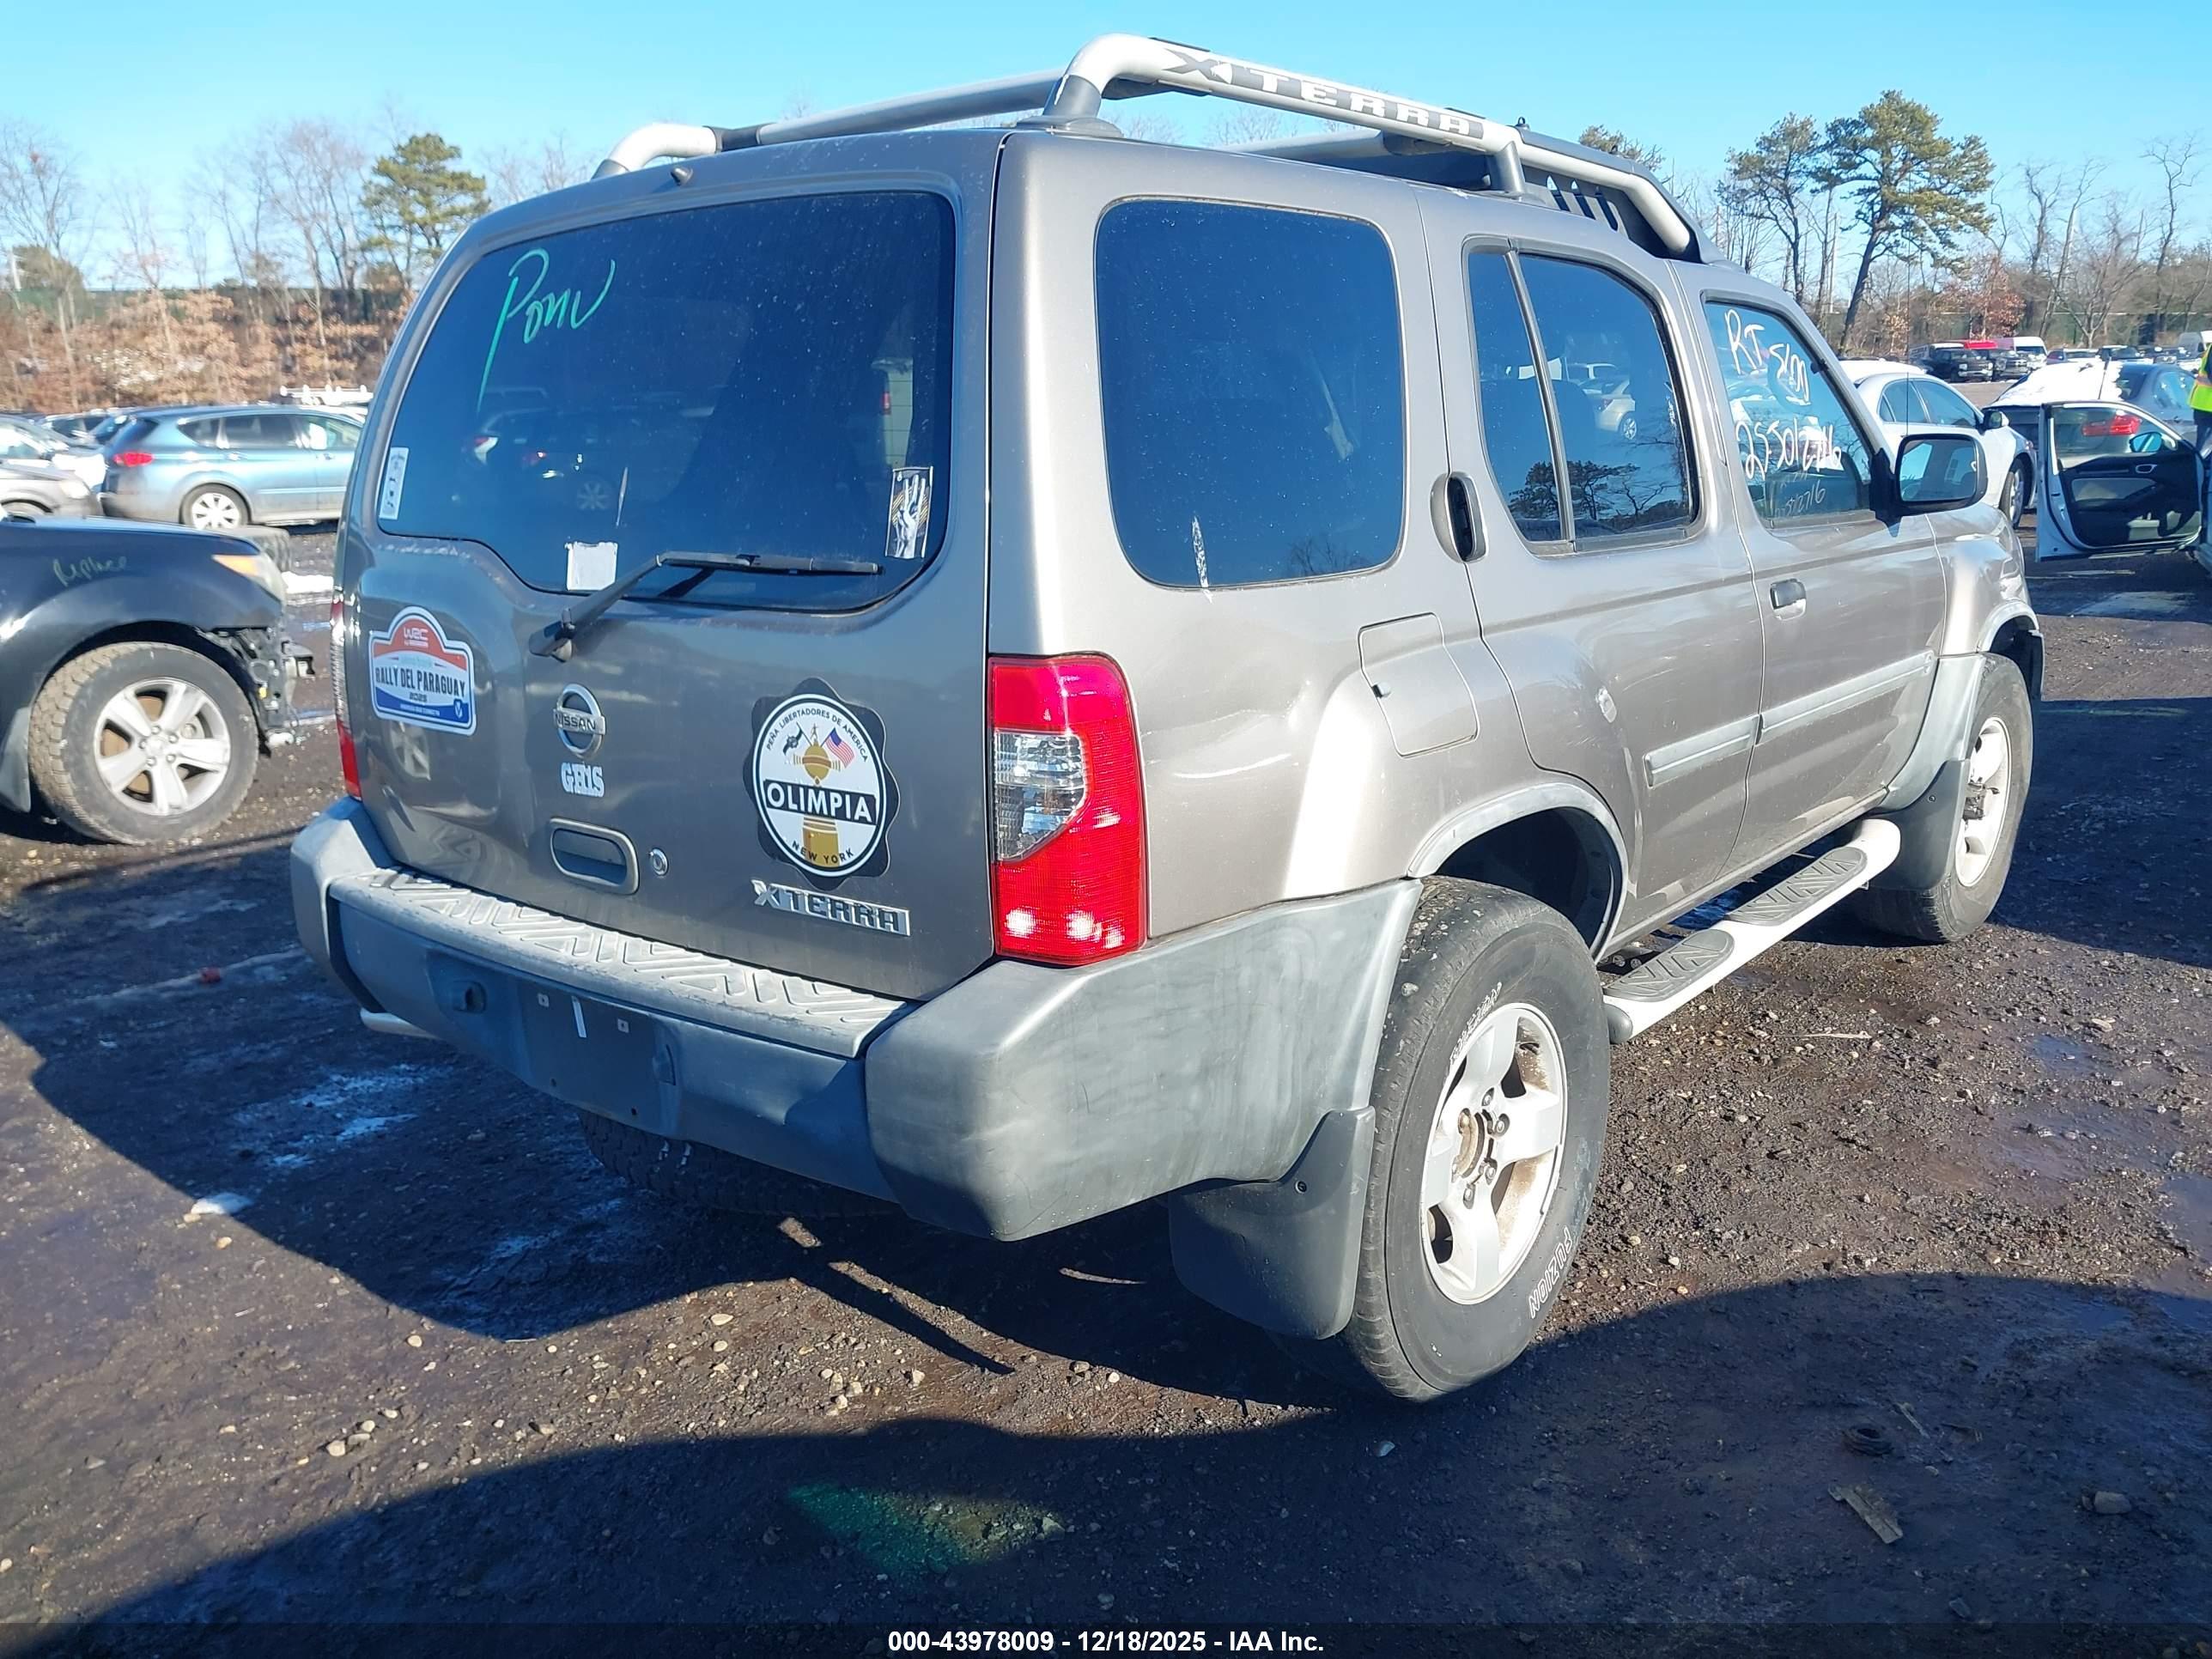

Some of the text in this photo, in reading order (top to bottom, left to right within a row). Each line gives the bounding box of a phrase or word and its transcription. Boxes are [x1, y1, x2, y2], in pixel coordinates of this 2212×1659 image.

[1163, 48, 1484, 140] XTERRA
[375, 666, 465, 697] RALLY DEL PARAGUAY
[555, 713, 597, 731] NISSAN
[766, 708, 868, 763] PEÑA LIBERTADORES DE AMERICA
[767, 783, 873, 823] OLIMPIA
[792, 840, 854, 864] NEW YORK
[751, 879, 910, 936] XTERRA
[1528, 1226, 1572, 1319] FUZION
